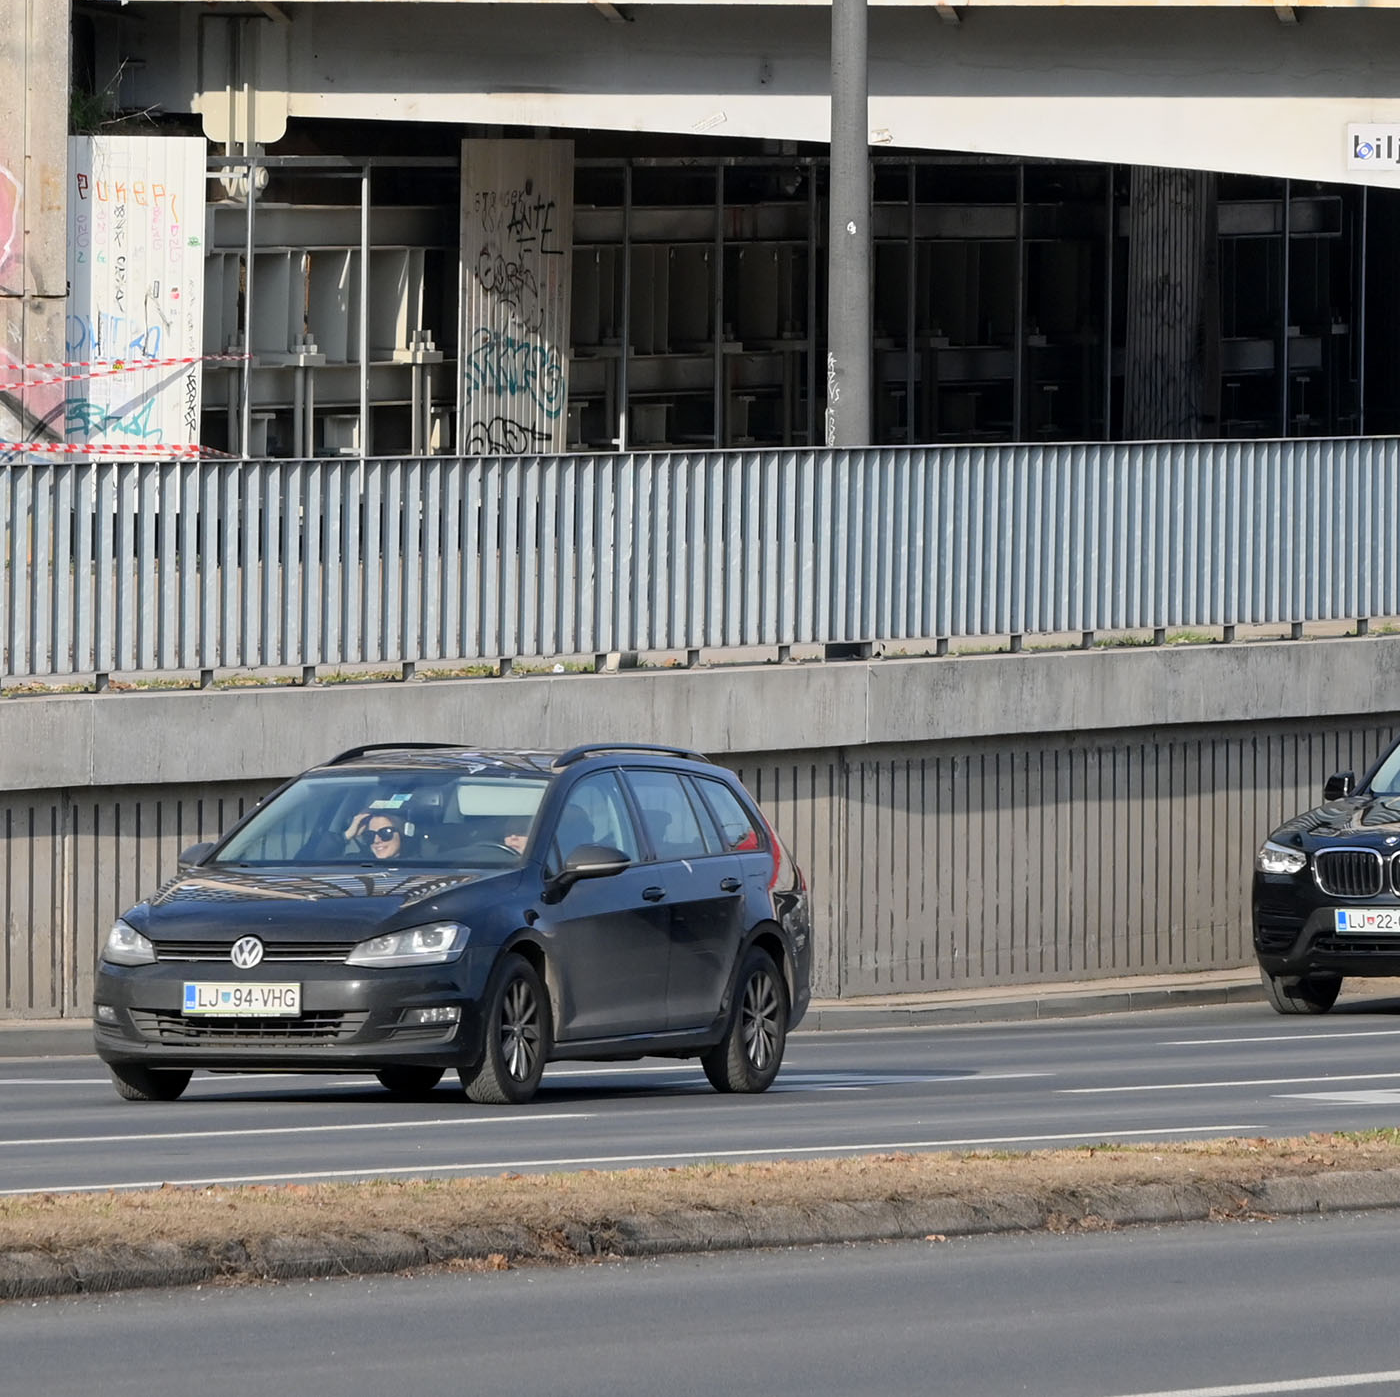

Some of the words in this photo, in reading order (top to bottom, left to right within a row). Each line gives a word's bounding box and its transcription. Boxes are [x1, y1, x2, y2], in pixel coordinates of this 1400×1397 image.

[1348, 914, 1366, 929] LJ
[198, 988, 219, 1008] LJ
[233, 988, 296, 1008] 94-VHG
